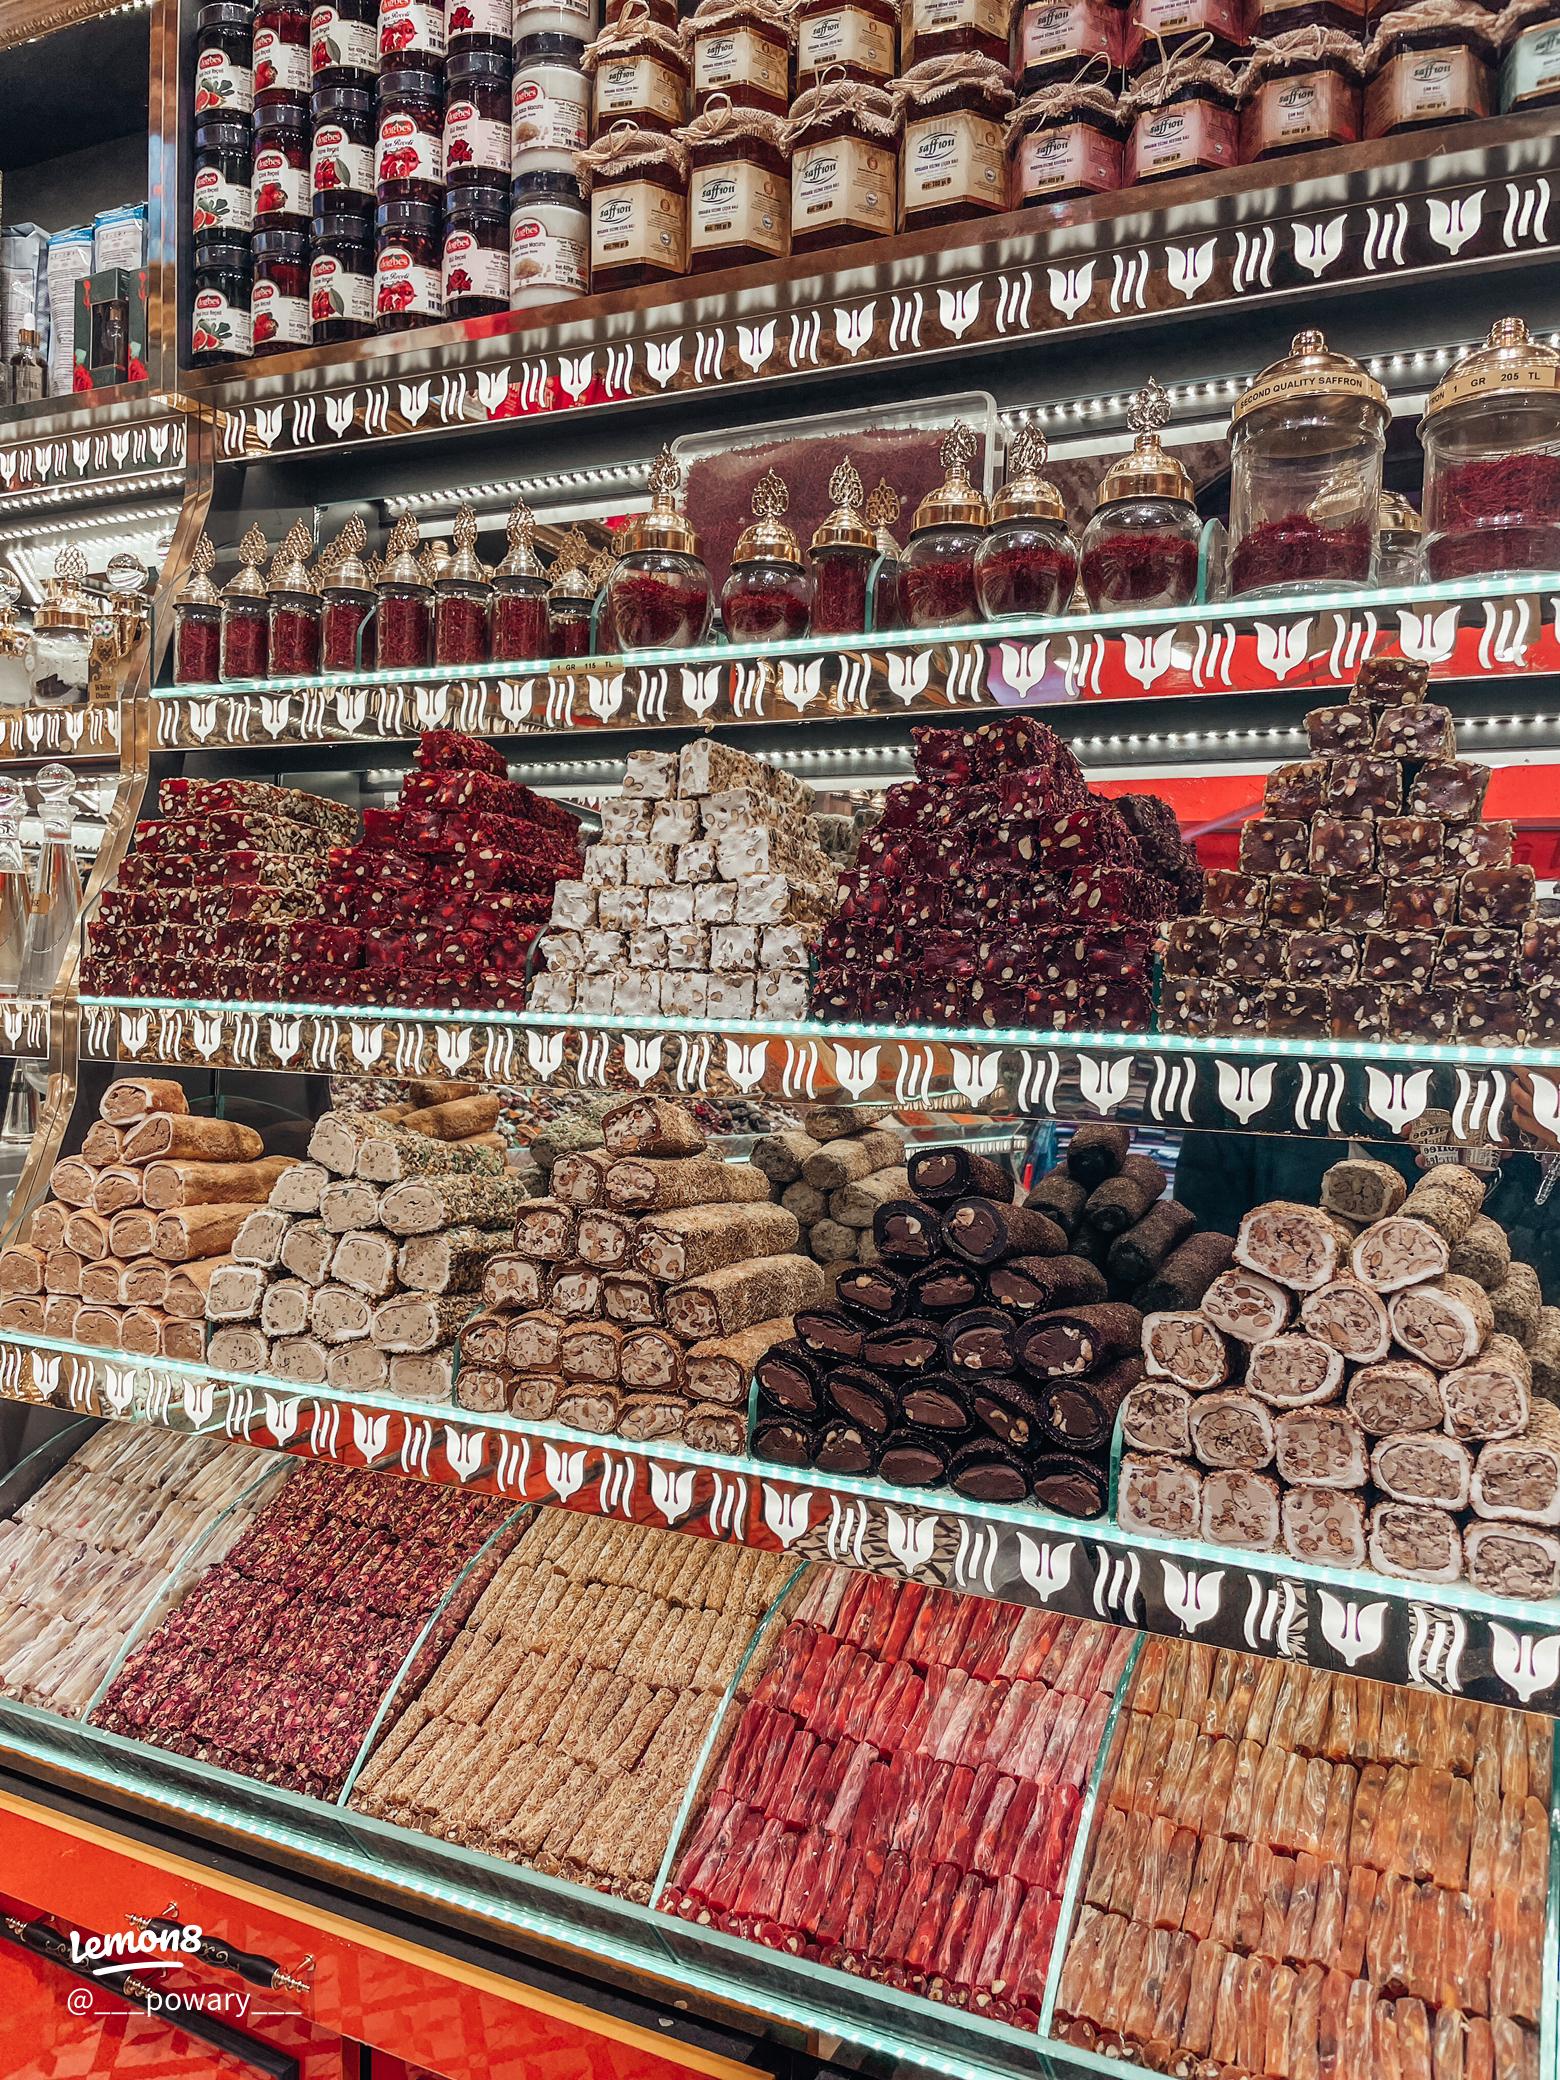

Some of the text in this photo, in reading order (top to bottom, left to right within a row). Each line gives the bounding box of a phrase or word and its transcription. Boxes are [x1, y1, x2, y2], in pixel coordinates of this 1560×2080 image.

[608, 68, 635, 81] saffron
[1414, 63, 1451, 79] saffron
[1279, 88, 1314, 105] saffron
[918, 138, 955, 157] saffron
[804, 162, 837, 181] saffron
[701, 183, 735, 201] saffron
[600, 203, 631, 220] saffron
[1453, 385, 1457, 393] 1
[1471, 377, 1486, 387] GR
[1501, 372, 1519, 382] 205
[1528, 371, 1540, 380] TL
[1240, 387, 1271, 409] SECOND
[1273, 377, 1316, 393] QUALITY
[1318, 376, 1363, 388] SAFFRON
